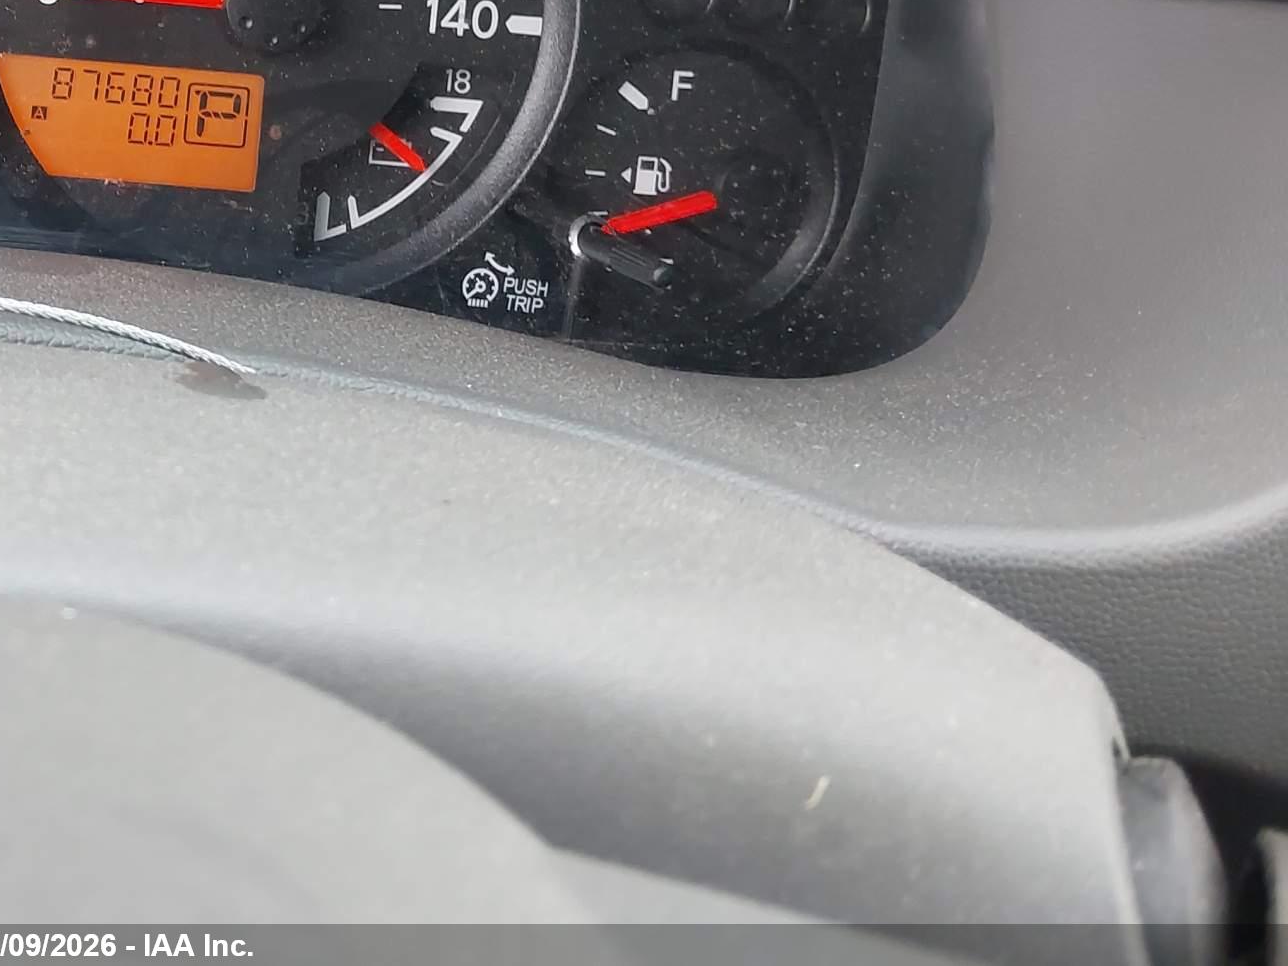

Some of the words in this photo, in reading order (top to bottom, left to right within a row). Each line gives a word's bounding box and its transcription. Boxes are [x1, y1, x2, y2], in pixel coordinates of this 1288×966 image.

[51, 66, 182, 110] 87680
[446, 69, 471, 95] 18
[671, 70, 695, 101] F
[194, 89, 242, 138] P
[127, 112, 177, 147] 0.0
[503, 276, 549, 298] PUSH
[505, 293, 544, 314] TRIP
